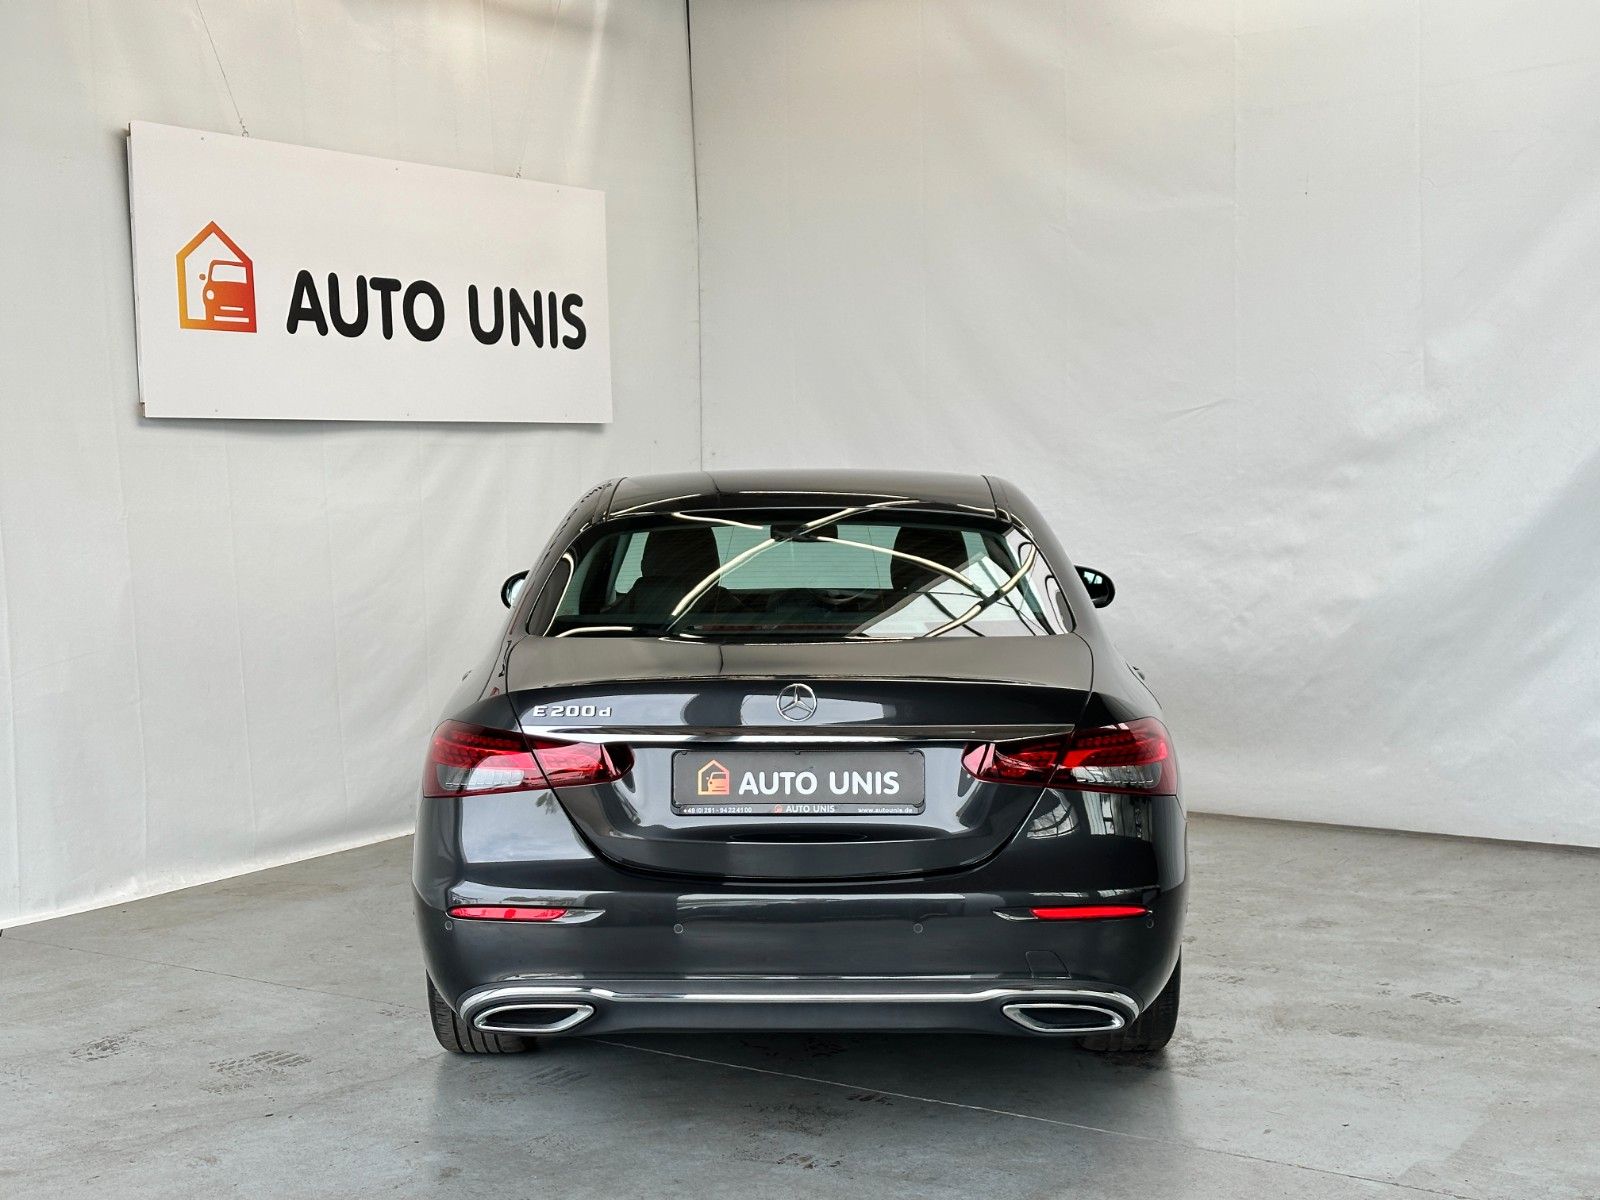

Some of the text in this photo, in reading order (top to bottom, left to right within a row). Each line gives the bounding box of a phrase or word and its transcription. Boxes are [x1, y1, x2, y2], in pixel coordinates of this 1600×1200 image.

[286, 269, 587, 350] AUTO UNIS
[738, 771, 901, 795] AUTO UNIS
[785, 804, 835, 813] AUTO UNIS
